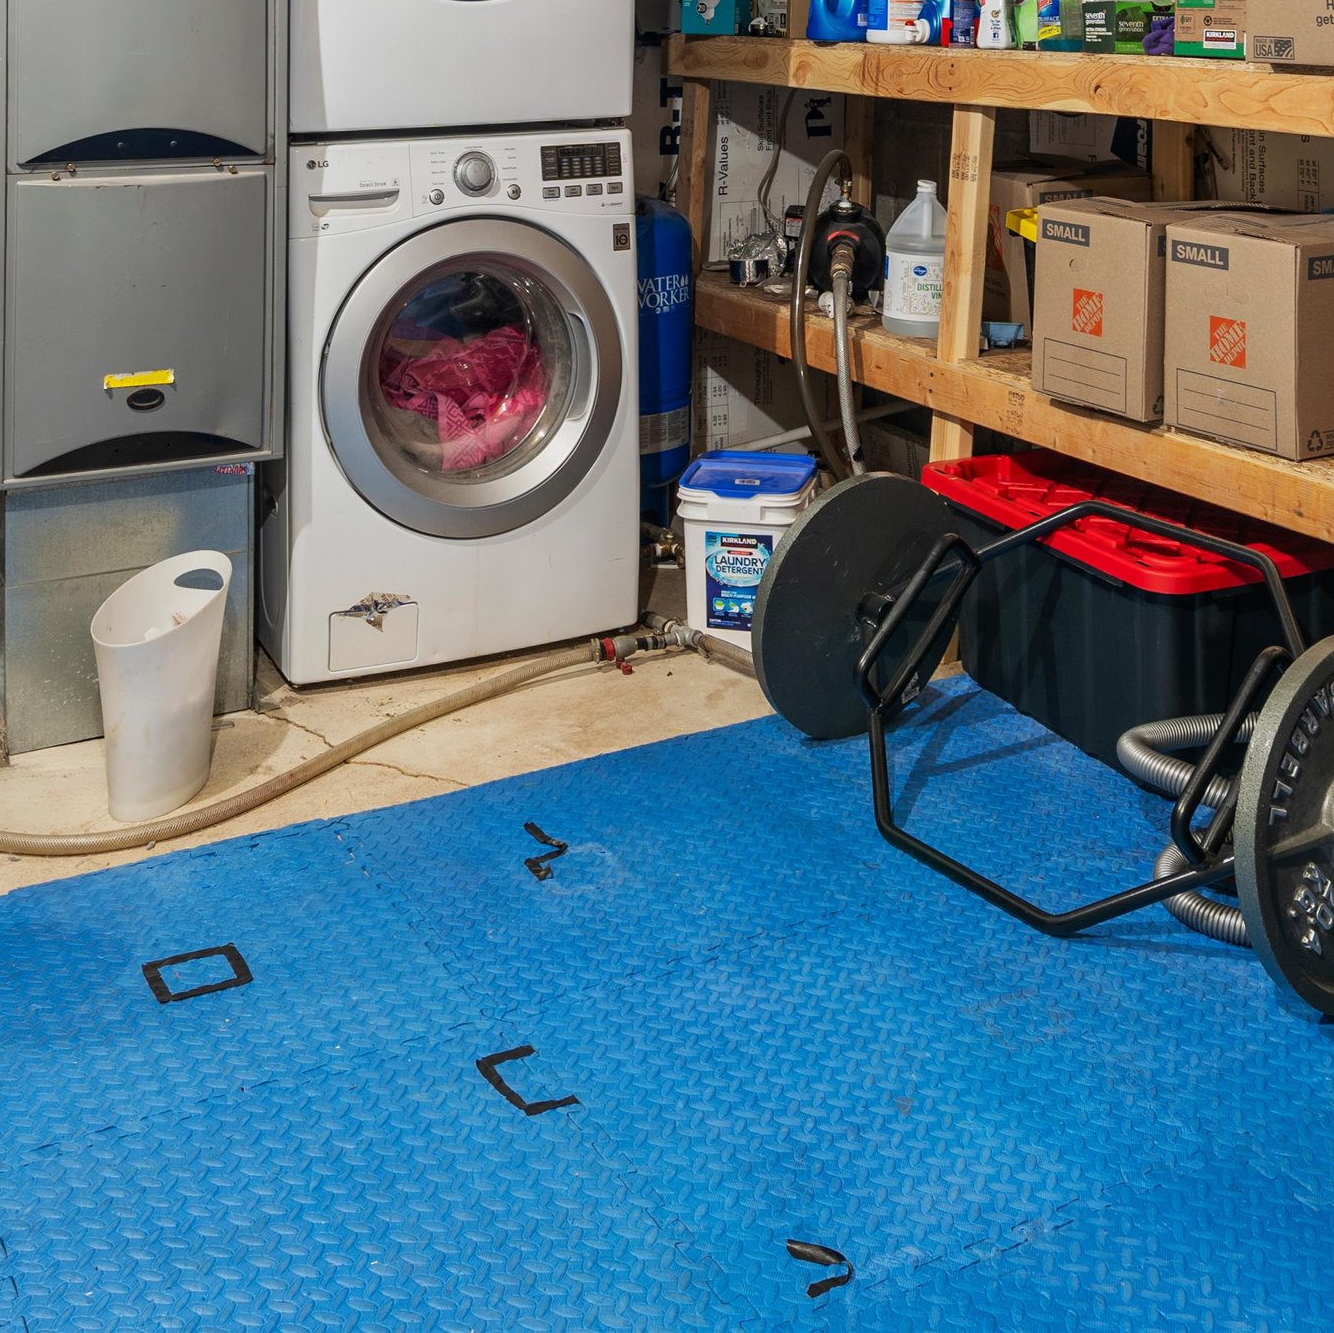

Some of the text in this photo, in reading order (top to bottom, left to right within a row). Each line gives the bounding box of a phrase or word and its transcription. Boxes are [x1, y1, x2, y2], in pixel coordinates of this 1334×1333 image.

[1315, 14, 1334, 28] get
[1255, 43, 1274, 58] USA
[718, 135, 729, 196] R-Values
[1045, 222, 1087, 243] SMALL
[1176, 244, 1224, 267] SMALL
[1072, 292, 1103, 333] HOME
[1210, 320, 1246, 364] HOME
[721, 536, 757, 545] KIRKLAND
[714, 555, 767, 567] LAUNDRY
[715, 565, 764, 575] DETERGENT
